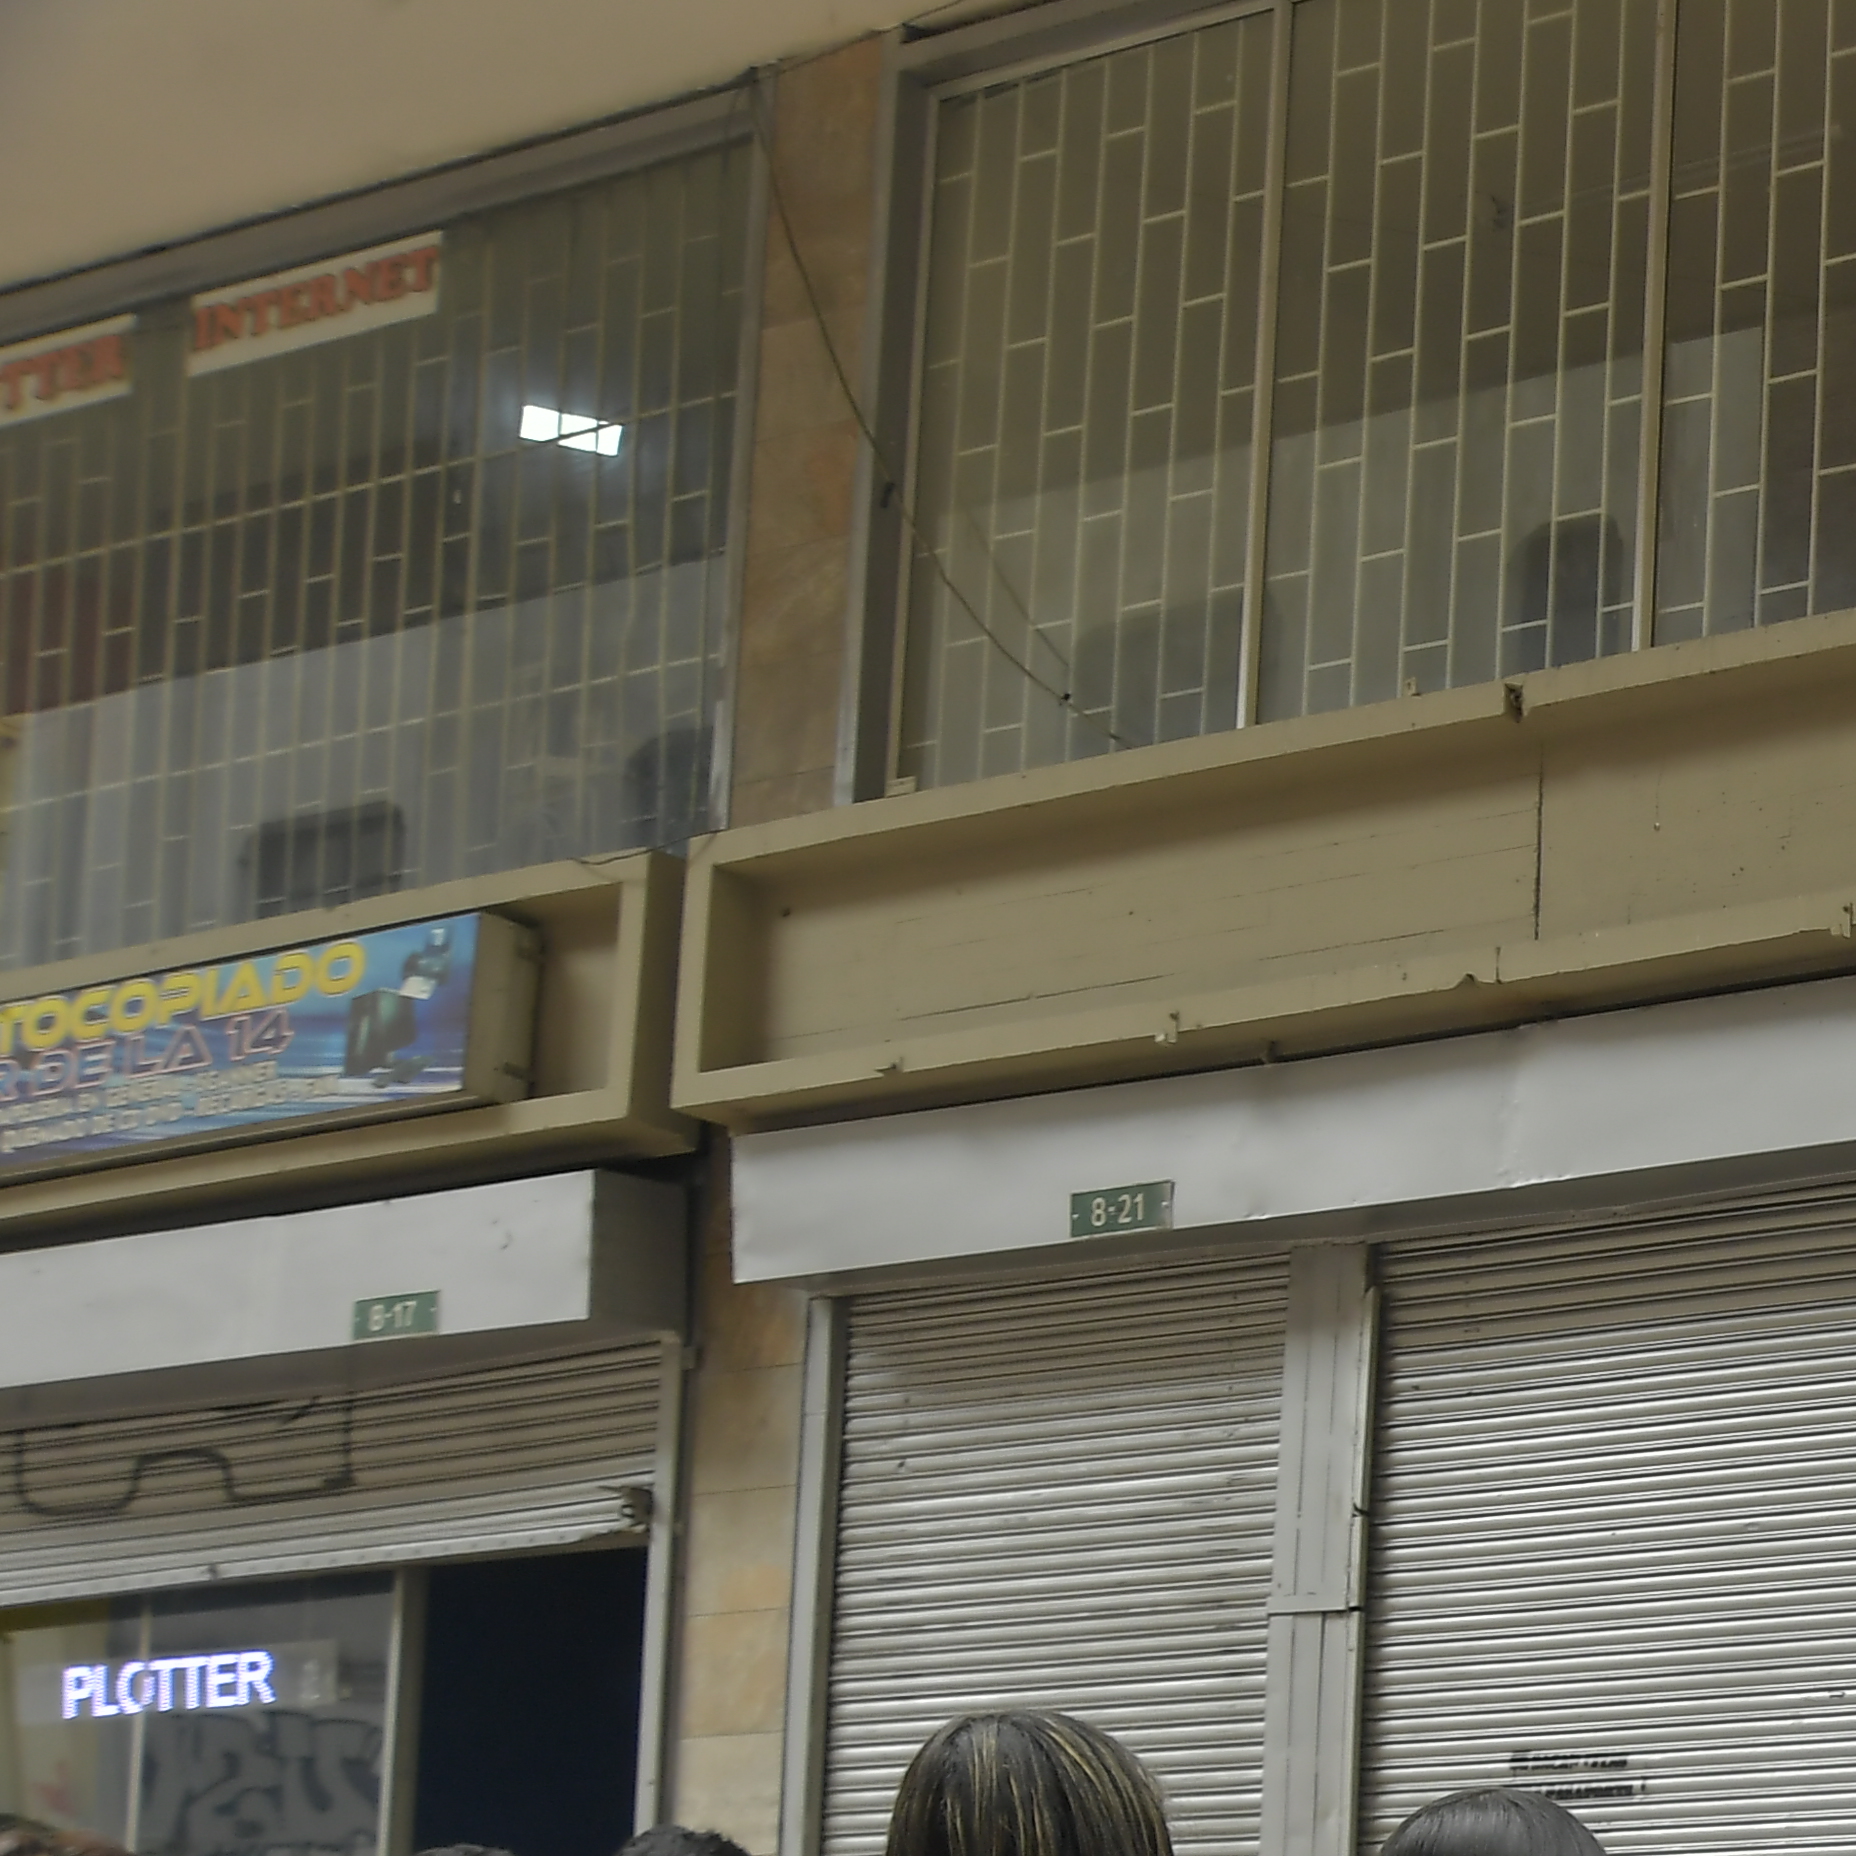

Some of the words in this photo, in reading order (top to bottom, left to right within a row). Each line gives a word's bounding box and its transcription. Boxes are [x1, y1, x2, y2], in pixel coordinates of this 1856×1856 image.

[193, 246, 438, 352] INTERNET
[0, 334, 125, 410] TTER
[0, 938, 366, 1050] TOCOPIADO
[124, 1024, 212, 1079] LA
[226, 1008, 295, 1061] 14
[1091, 1192, 1144, 1227] 8-21
[368, 1300, 417, 1332] 8-17
[61, 1650, 276, 1720] PLOTTER
